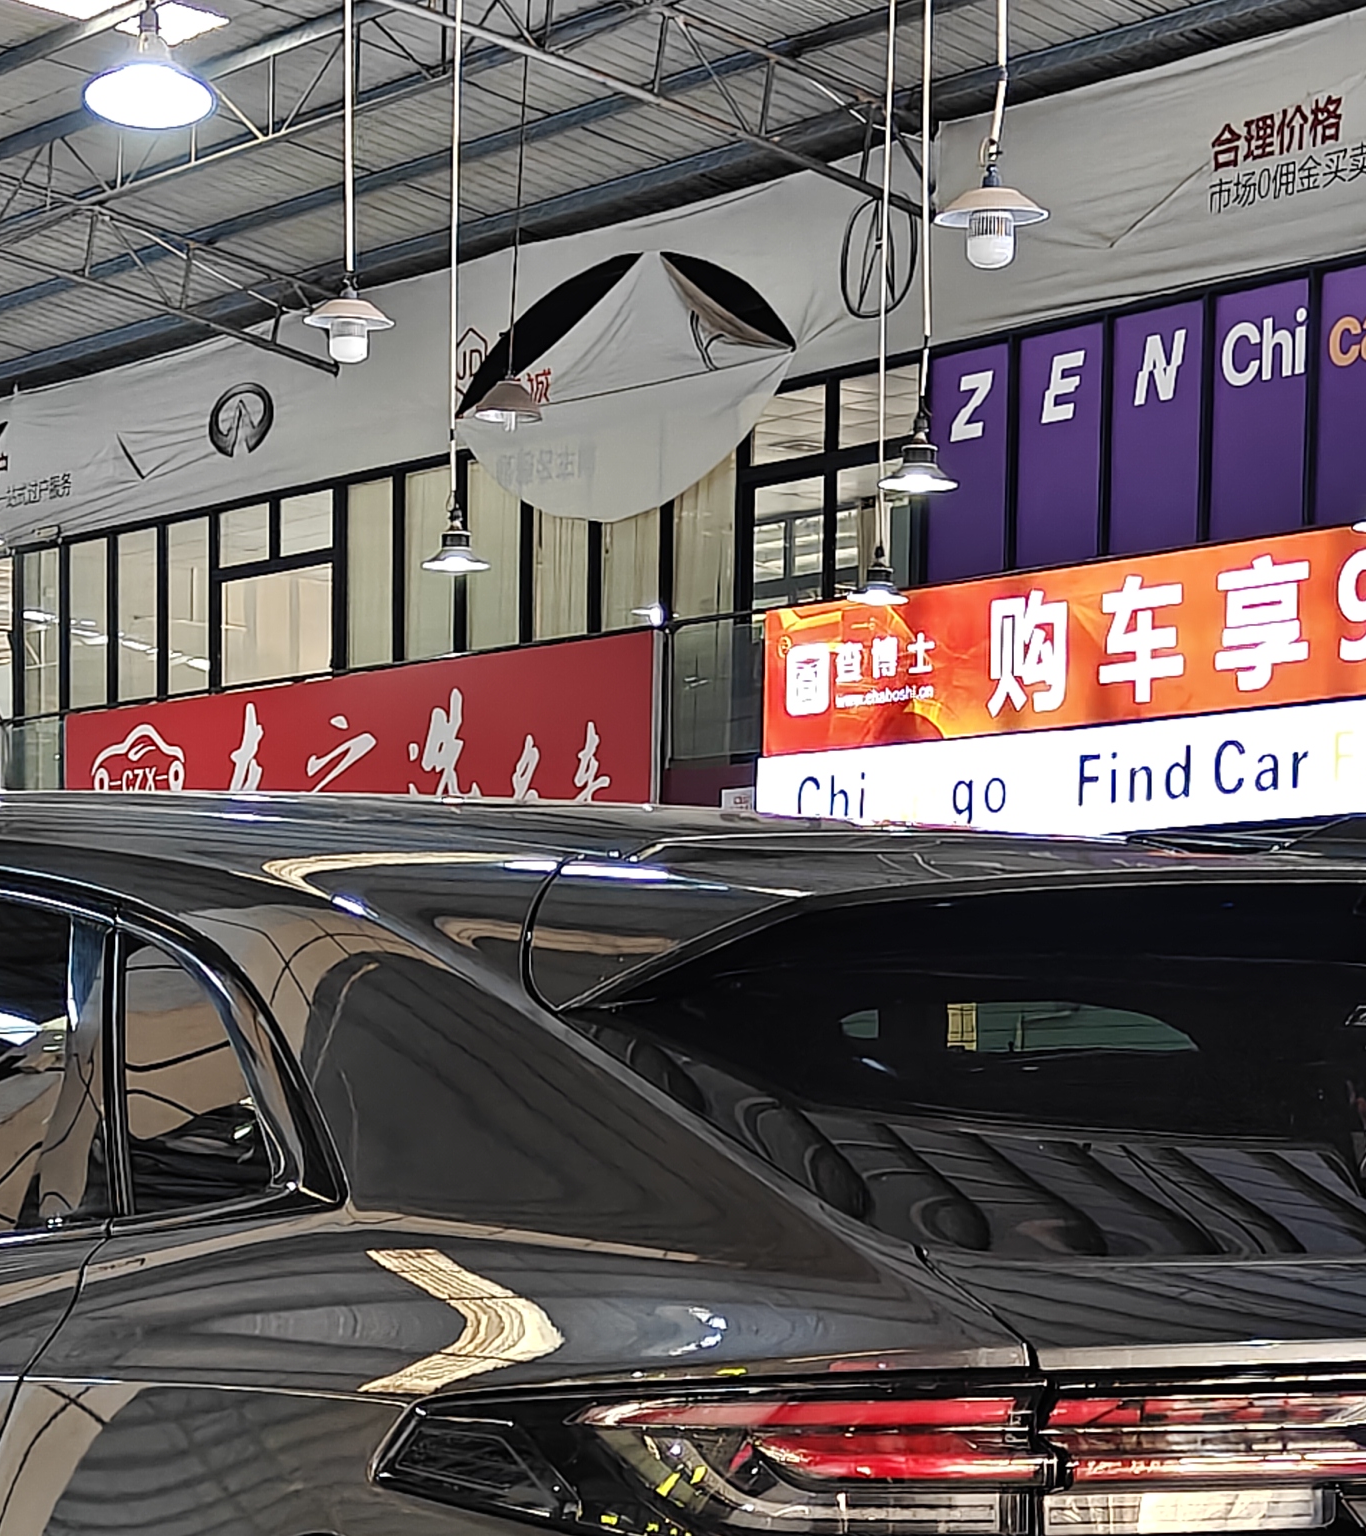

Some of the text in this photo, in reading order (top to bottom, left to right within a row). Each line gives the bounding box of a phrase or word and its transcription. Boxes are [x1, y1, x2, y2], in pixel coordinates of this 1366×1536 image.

[1210, 94, 1344, 172] 合理价格
[1077, 744, 1192, 807] Find
[1214, 739, 1310, 795] Car
